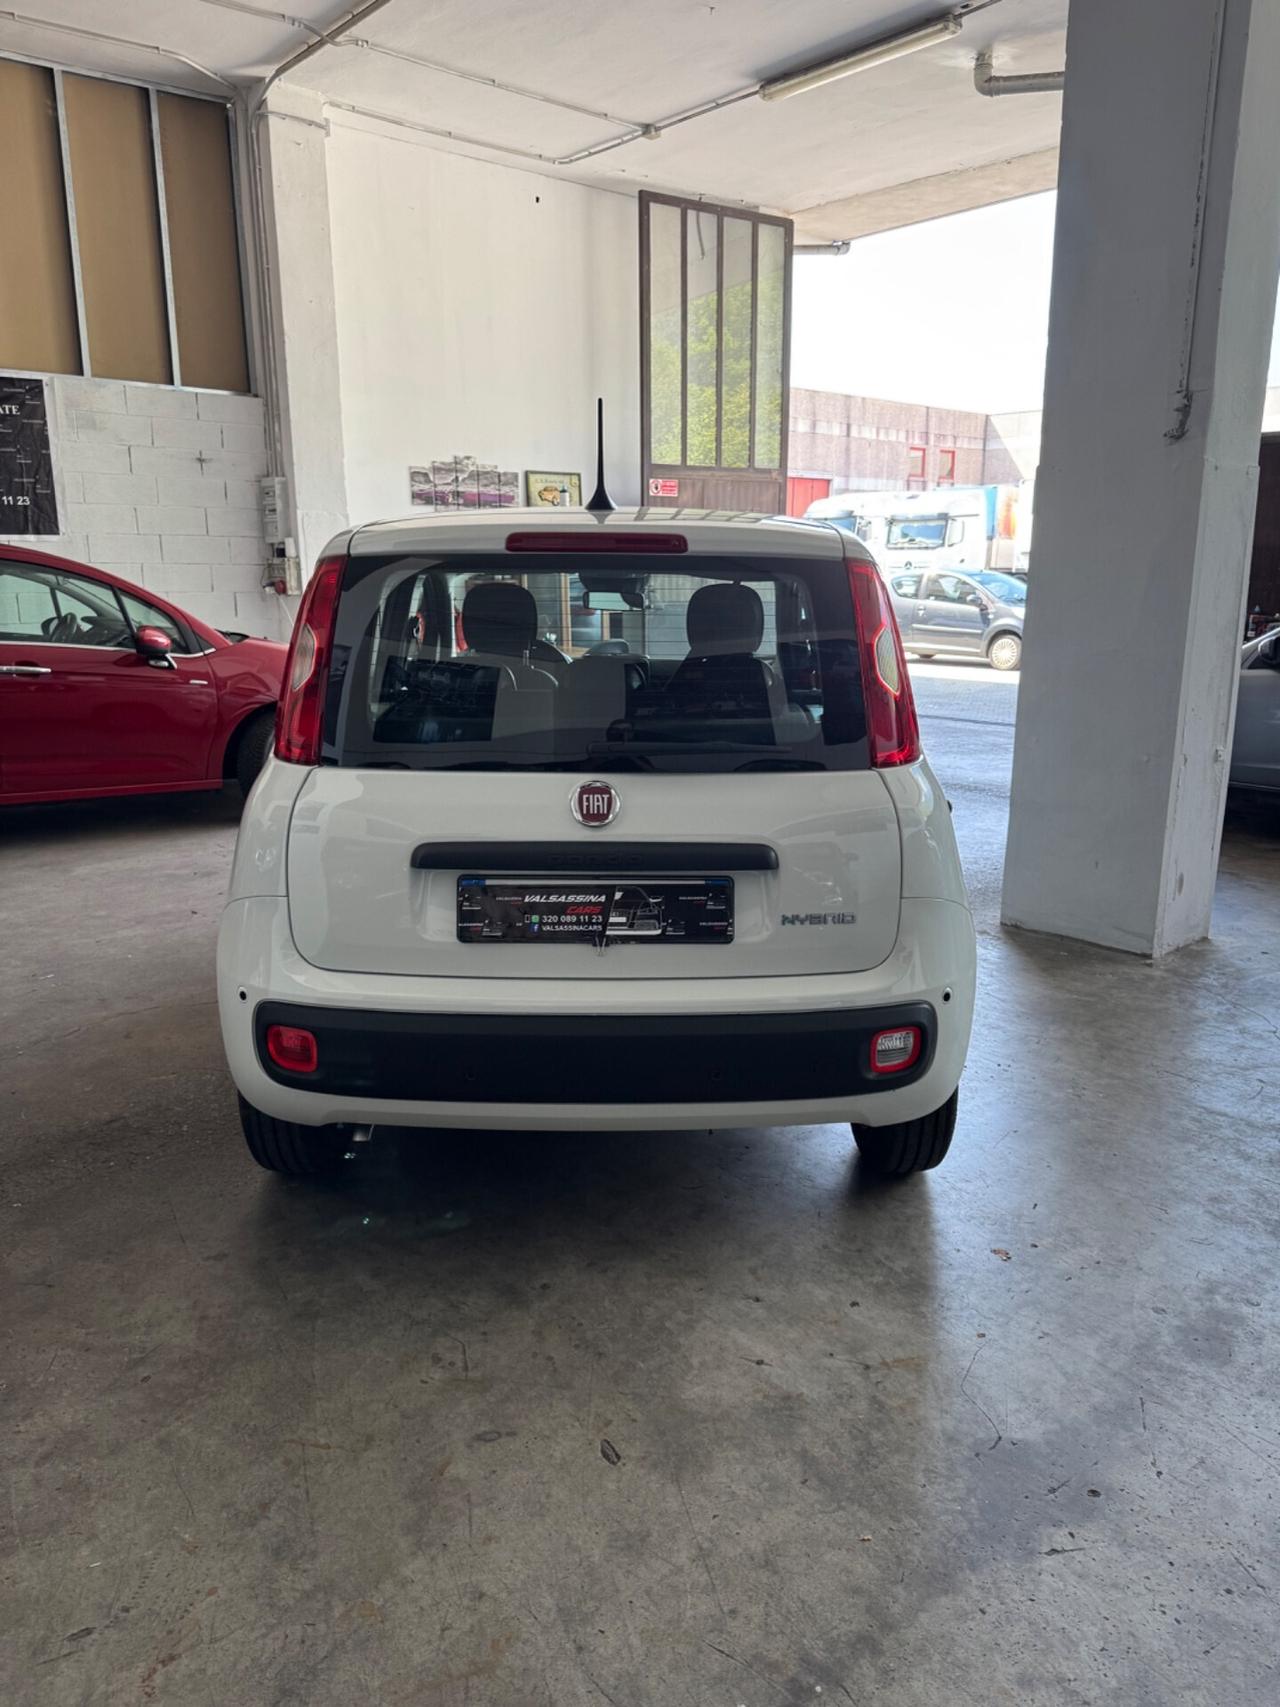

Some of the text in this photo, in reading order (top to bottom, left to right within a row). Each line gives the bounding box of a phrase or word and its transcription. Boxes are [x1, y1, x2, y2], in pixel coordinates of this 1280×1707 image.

[2, 495, 31, 506] 11 23
[582, 794, 610, 815] FIAT
[523, 894, 606, 903] VALSASSINA
[566, 905, 604, 914] CARS
[542, 914, 603, 923] 320 089 11 23
[541, 924, 603, 932] VALSASSINACARS
